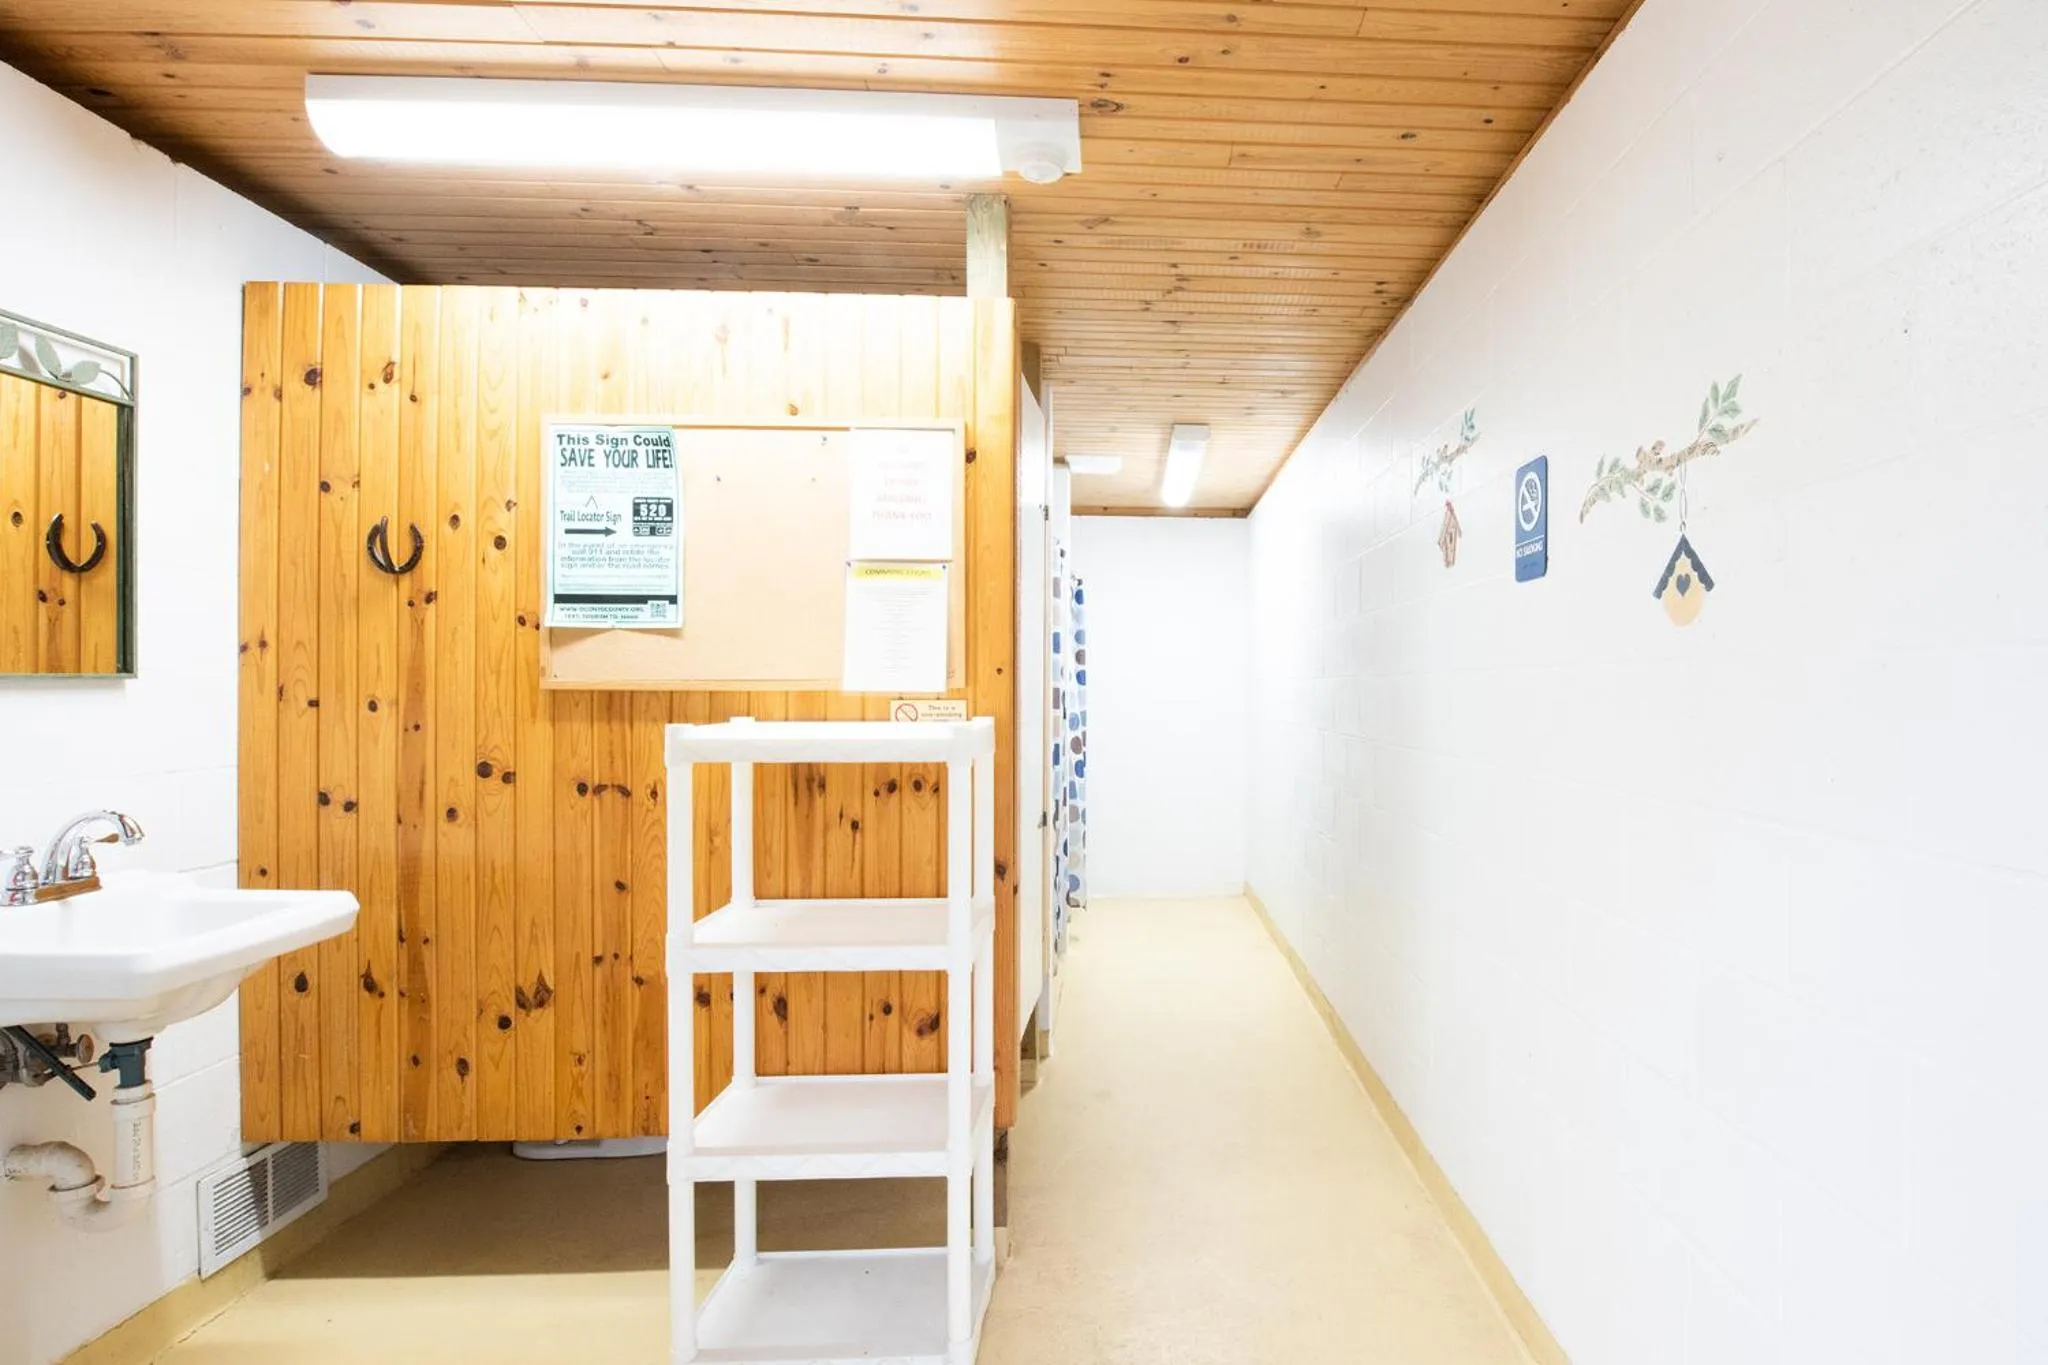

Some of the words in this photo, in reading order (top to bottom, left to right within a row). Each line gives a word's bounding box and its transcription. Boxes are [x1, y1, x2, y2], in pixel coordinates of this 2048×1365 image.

[557, 434, 590, 446] This
[595, 434, 629, 449] Sign
[633, 434, 671, 448] Could
[560, 447, 596, 468] SAVE
[603, 448, 639, 469] YOUR
[645, 448, 674, 469] LIFE!
[640, 503, 667, 517] 520
[560, 510, 576, 523] Trail
[577, 510, 604, 523] Locator
[605, 511, 622, 526] Sign
